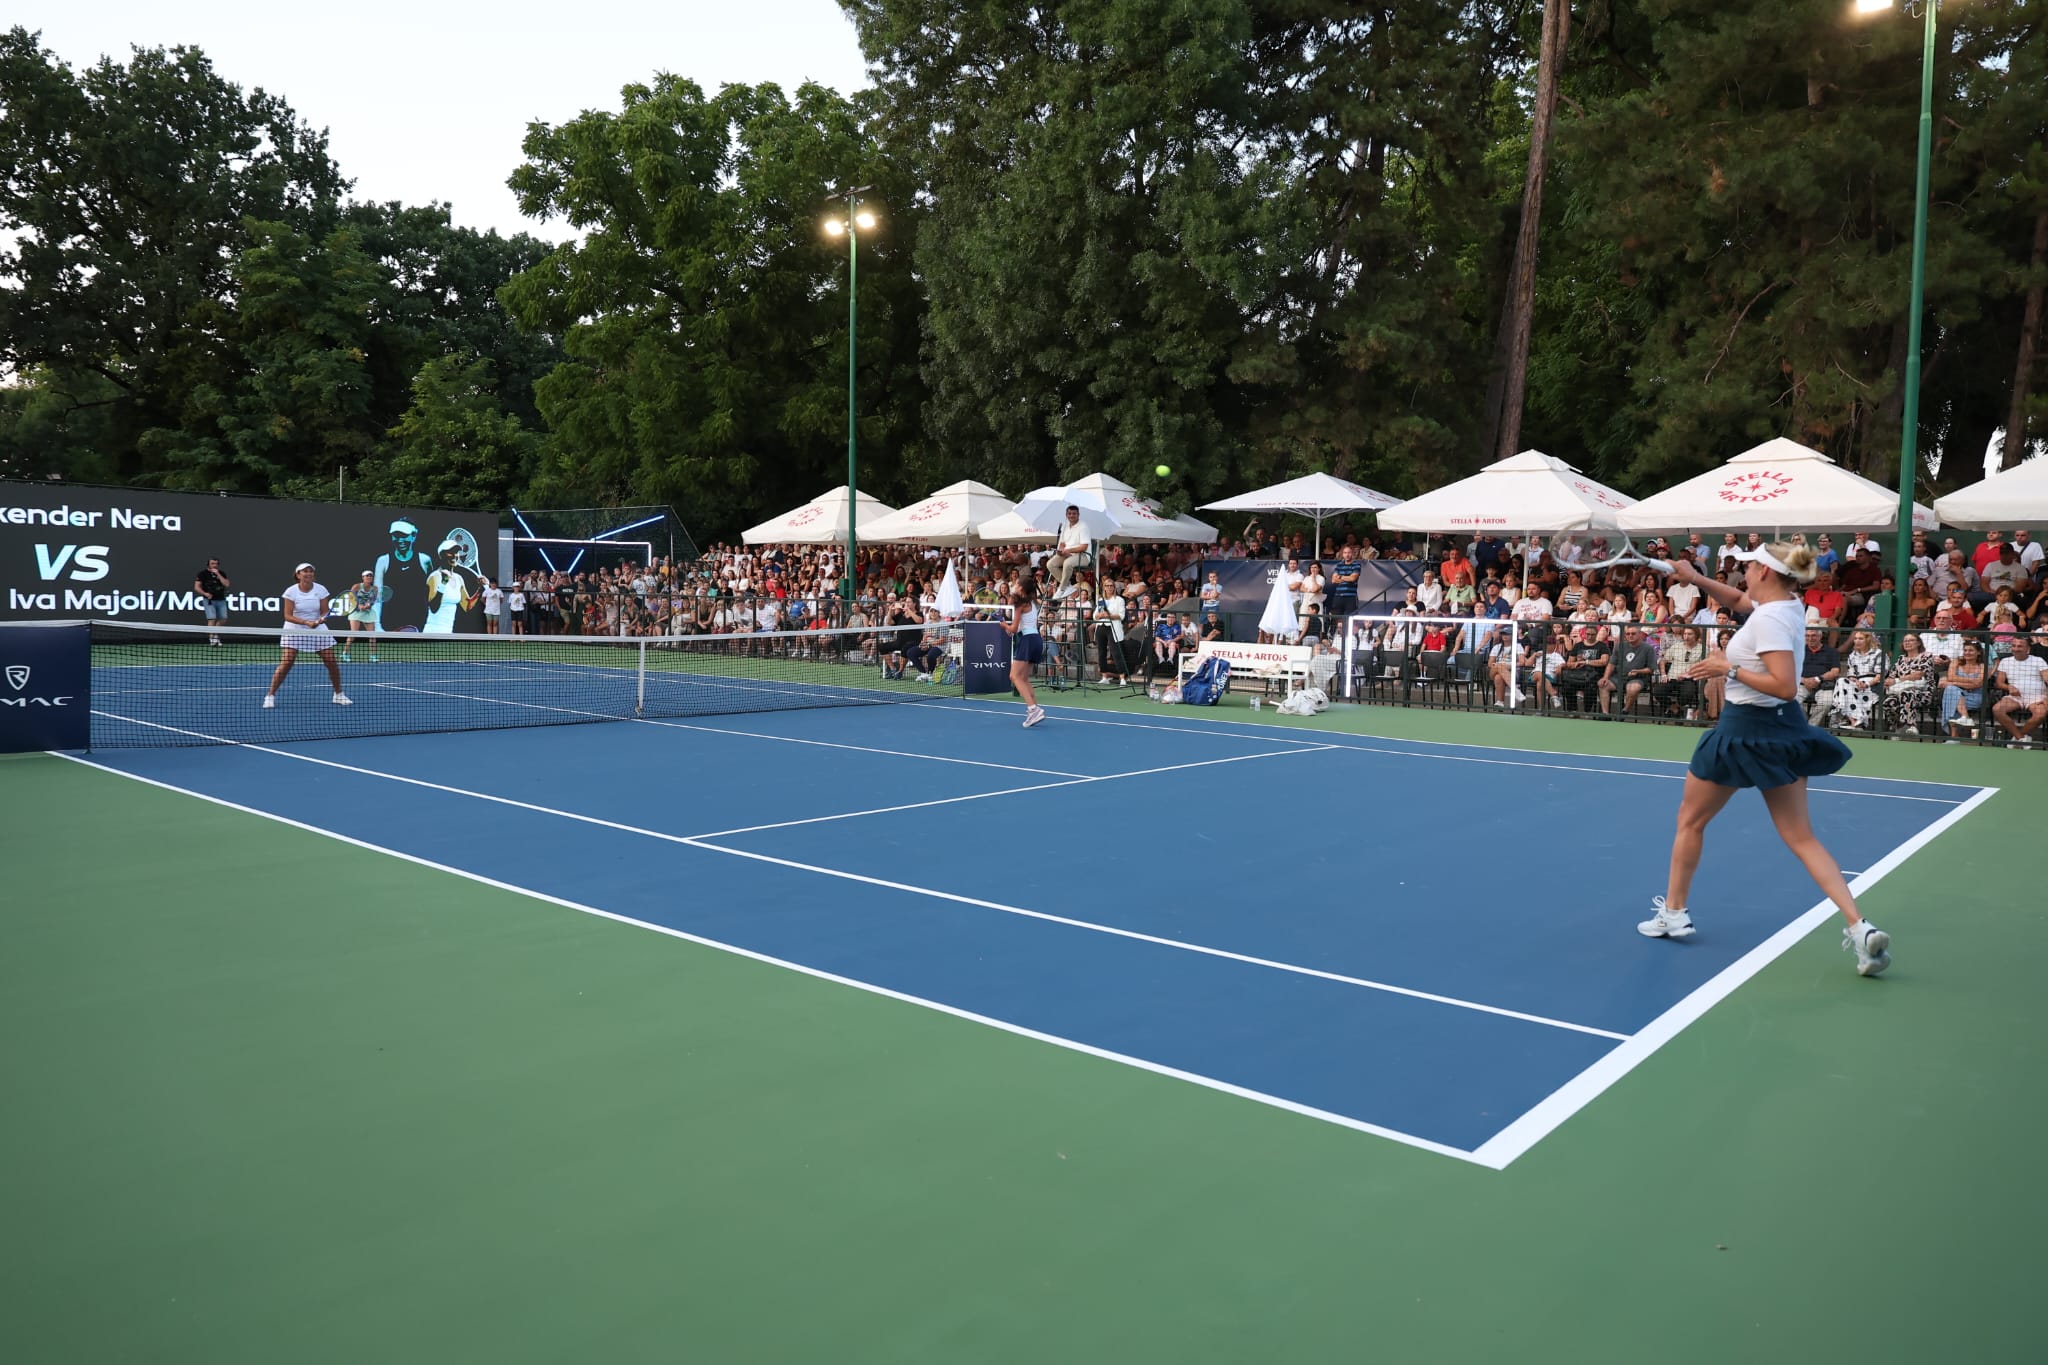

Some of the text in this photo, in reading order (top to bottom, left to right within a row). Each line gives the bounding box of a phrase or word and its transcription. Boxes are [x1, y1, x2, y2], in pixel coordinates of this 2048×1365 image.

[1724, 471, 1793, 487] STELLA
[1718, 488, 1789, 503] ARTOIS
[110, 508, 182, 531] Nera
[34, 543, 110, 581] VS
[9, 588, 280, 616] Iva Majoli/Matina
[1211, 649, 1243, 659] STELLA
[970, 661, 1008, 669] RIMAC
